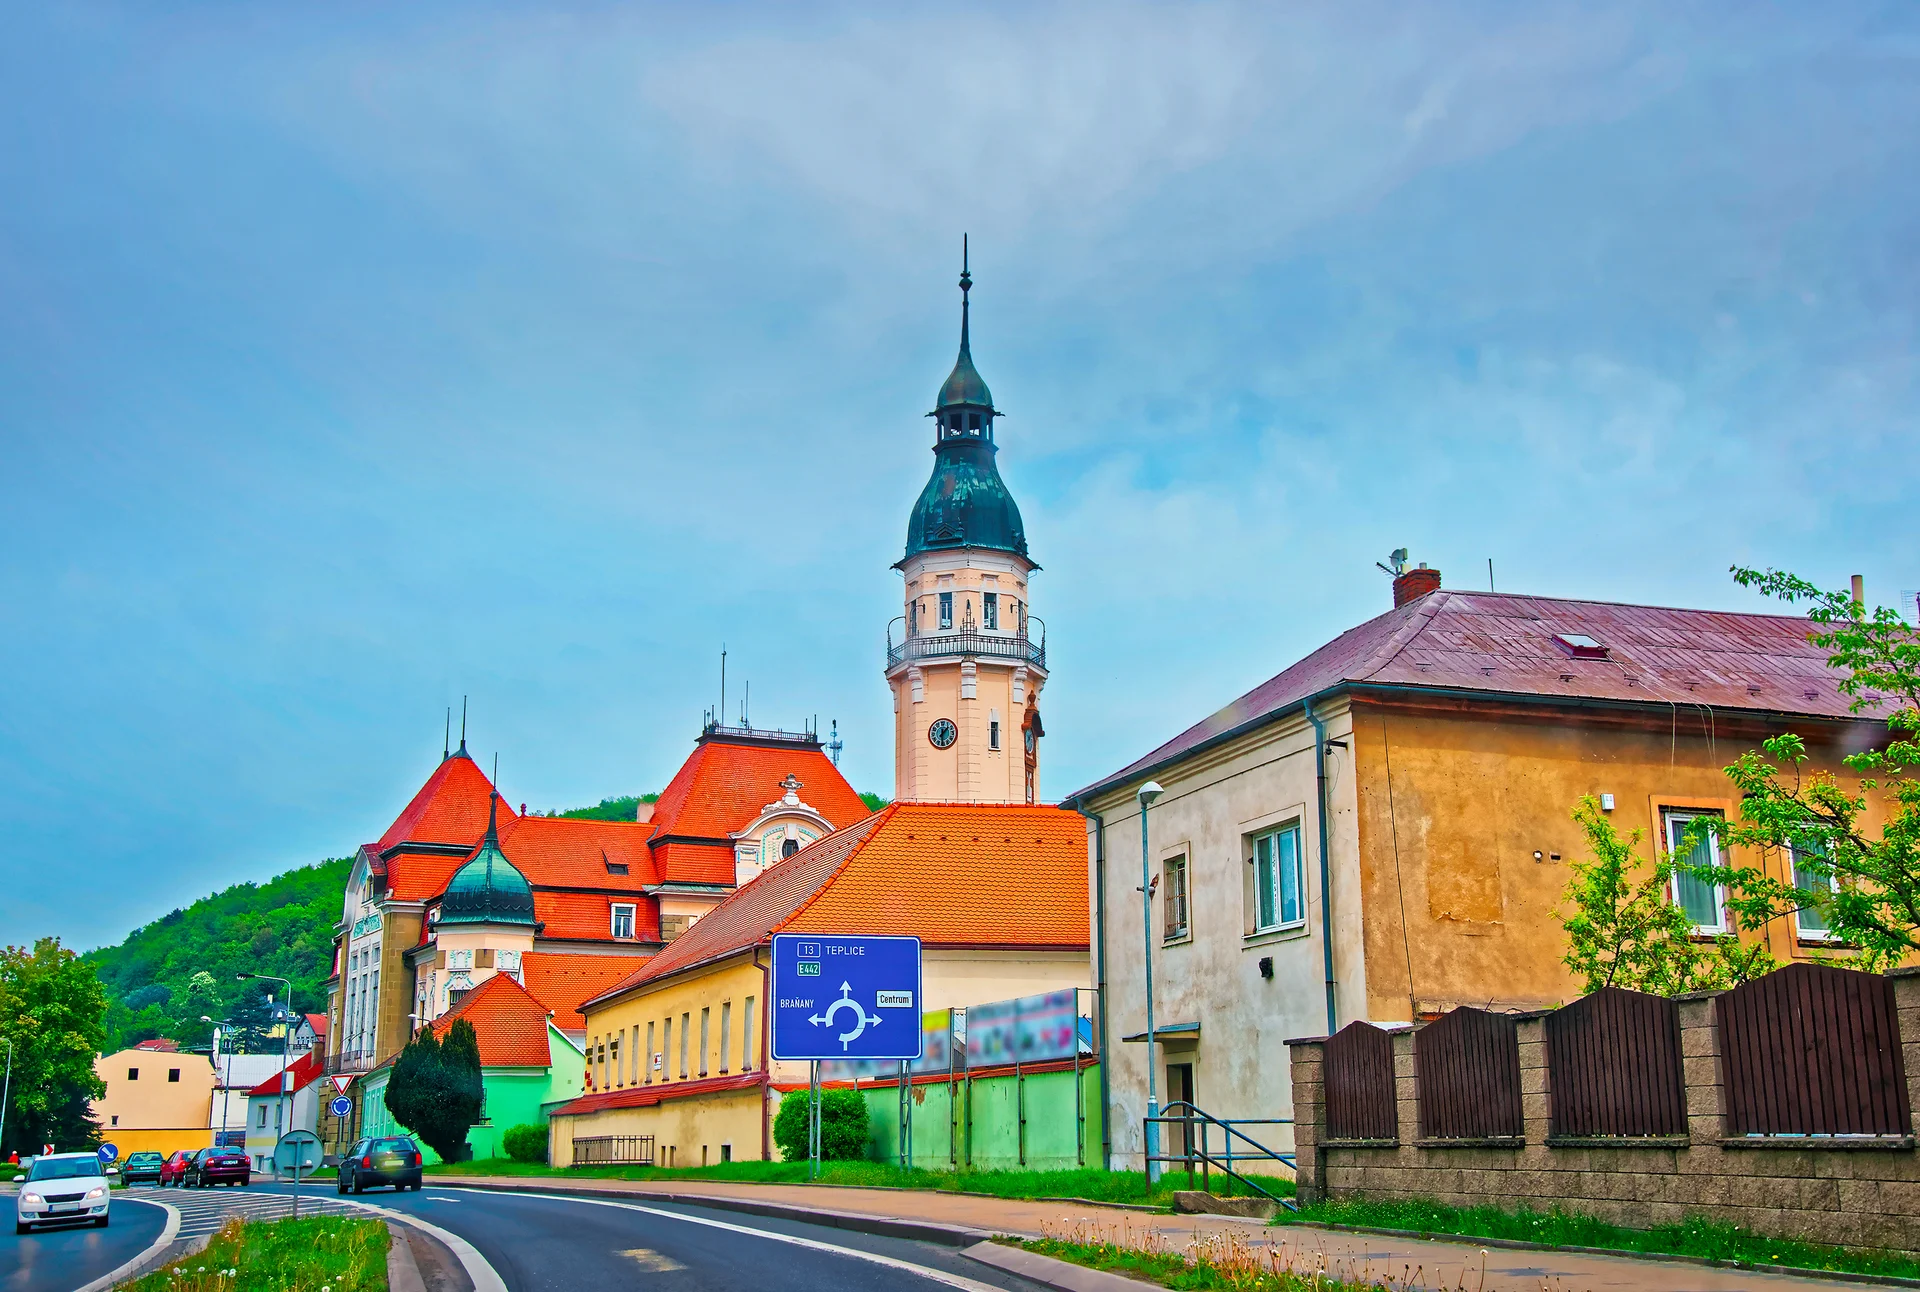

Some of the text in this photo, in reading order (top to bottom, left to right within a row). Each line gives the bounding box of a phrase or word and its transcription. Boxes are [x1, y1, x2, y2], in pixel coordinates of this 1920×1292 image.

[804, 945, 865, 956] 13 TEPLICE
[780, 996, 815, 1008] BRAŇANY
[880, 994, 910, 1004] Centrum
